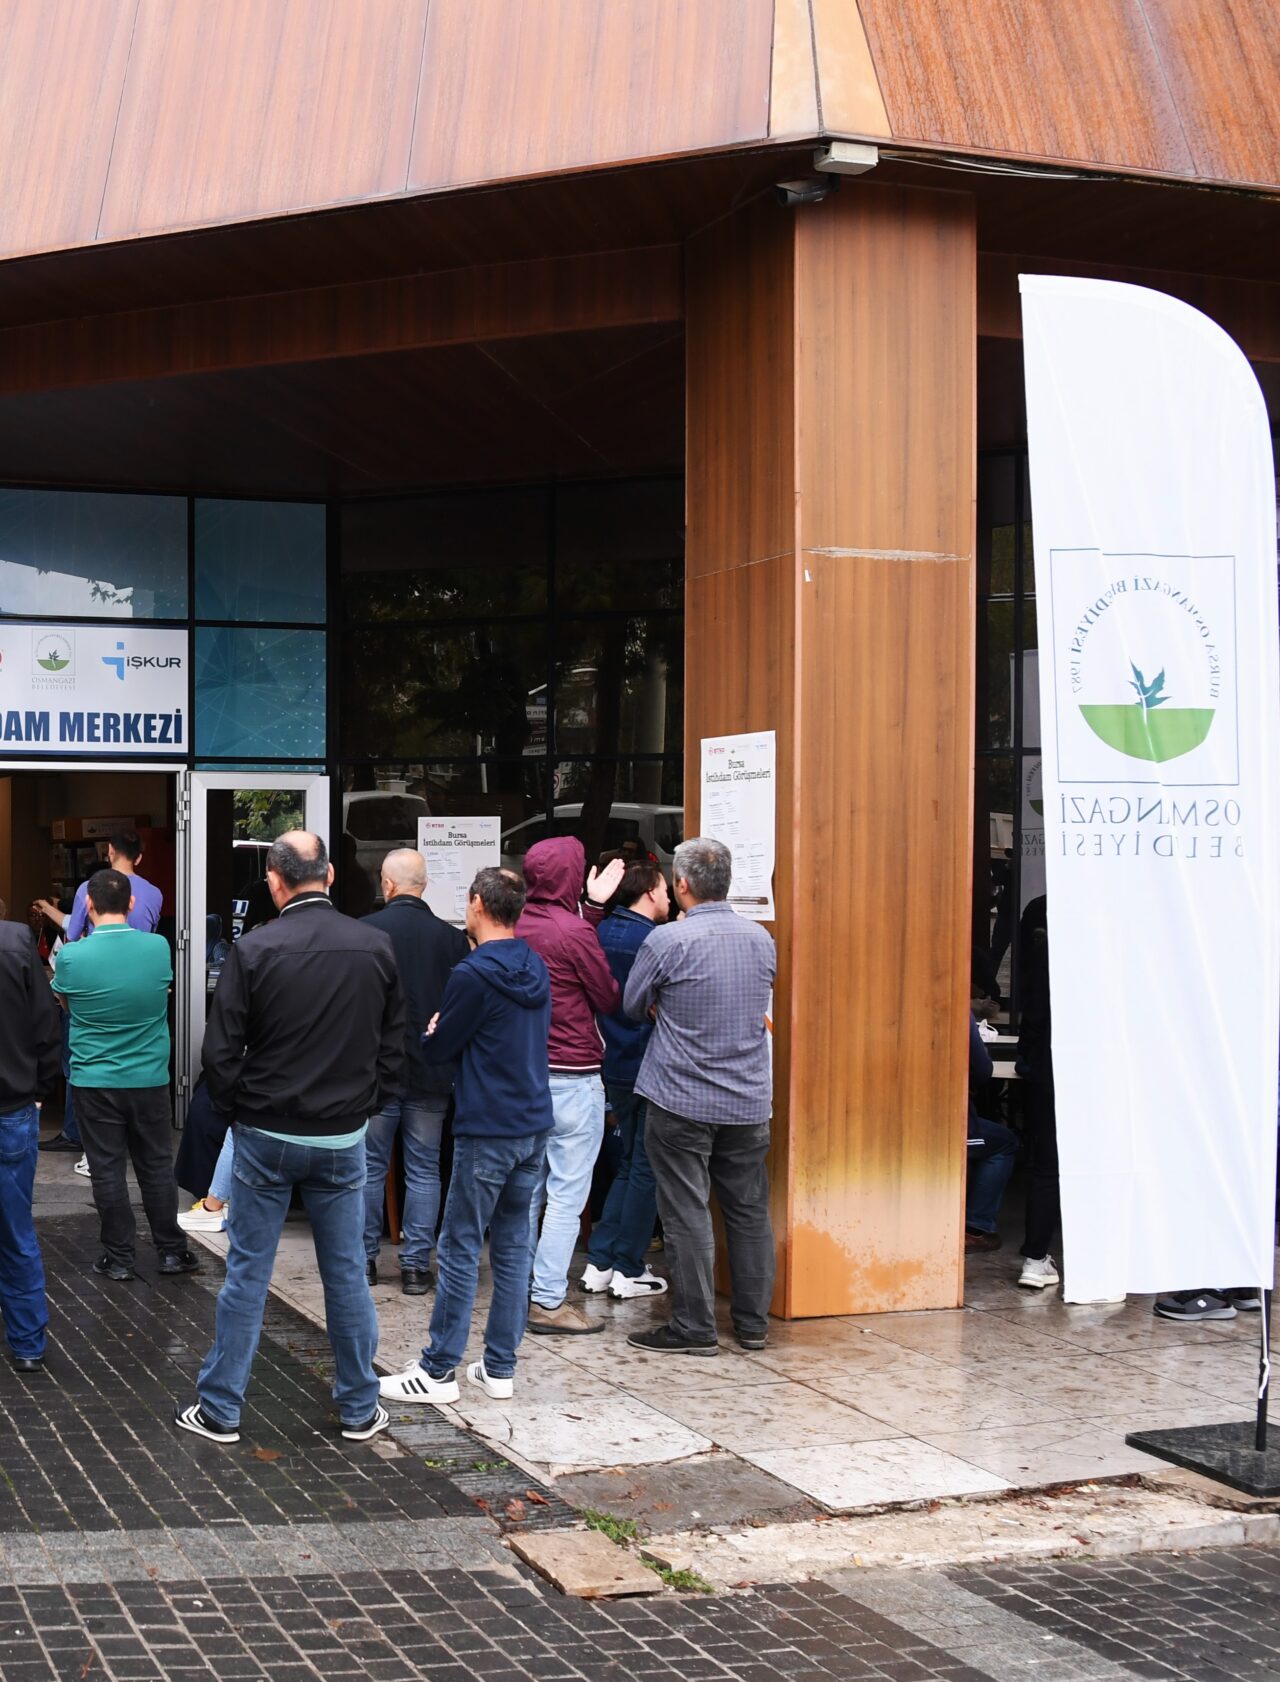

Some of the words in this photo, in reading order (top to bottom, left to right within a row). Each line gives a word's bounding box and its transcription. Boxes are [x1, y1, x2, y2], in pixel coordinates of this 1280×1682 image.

[59, 708, 182, 744] MERKEZİ
[448, 831, 467, 839] Bursa
[454, 838, 496, 848] Görüşmeleri
